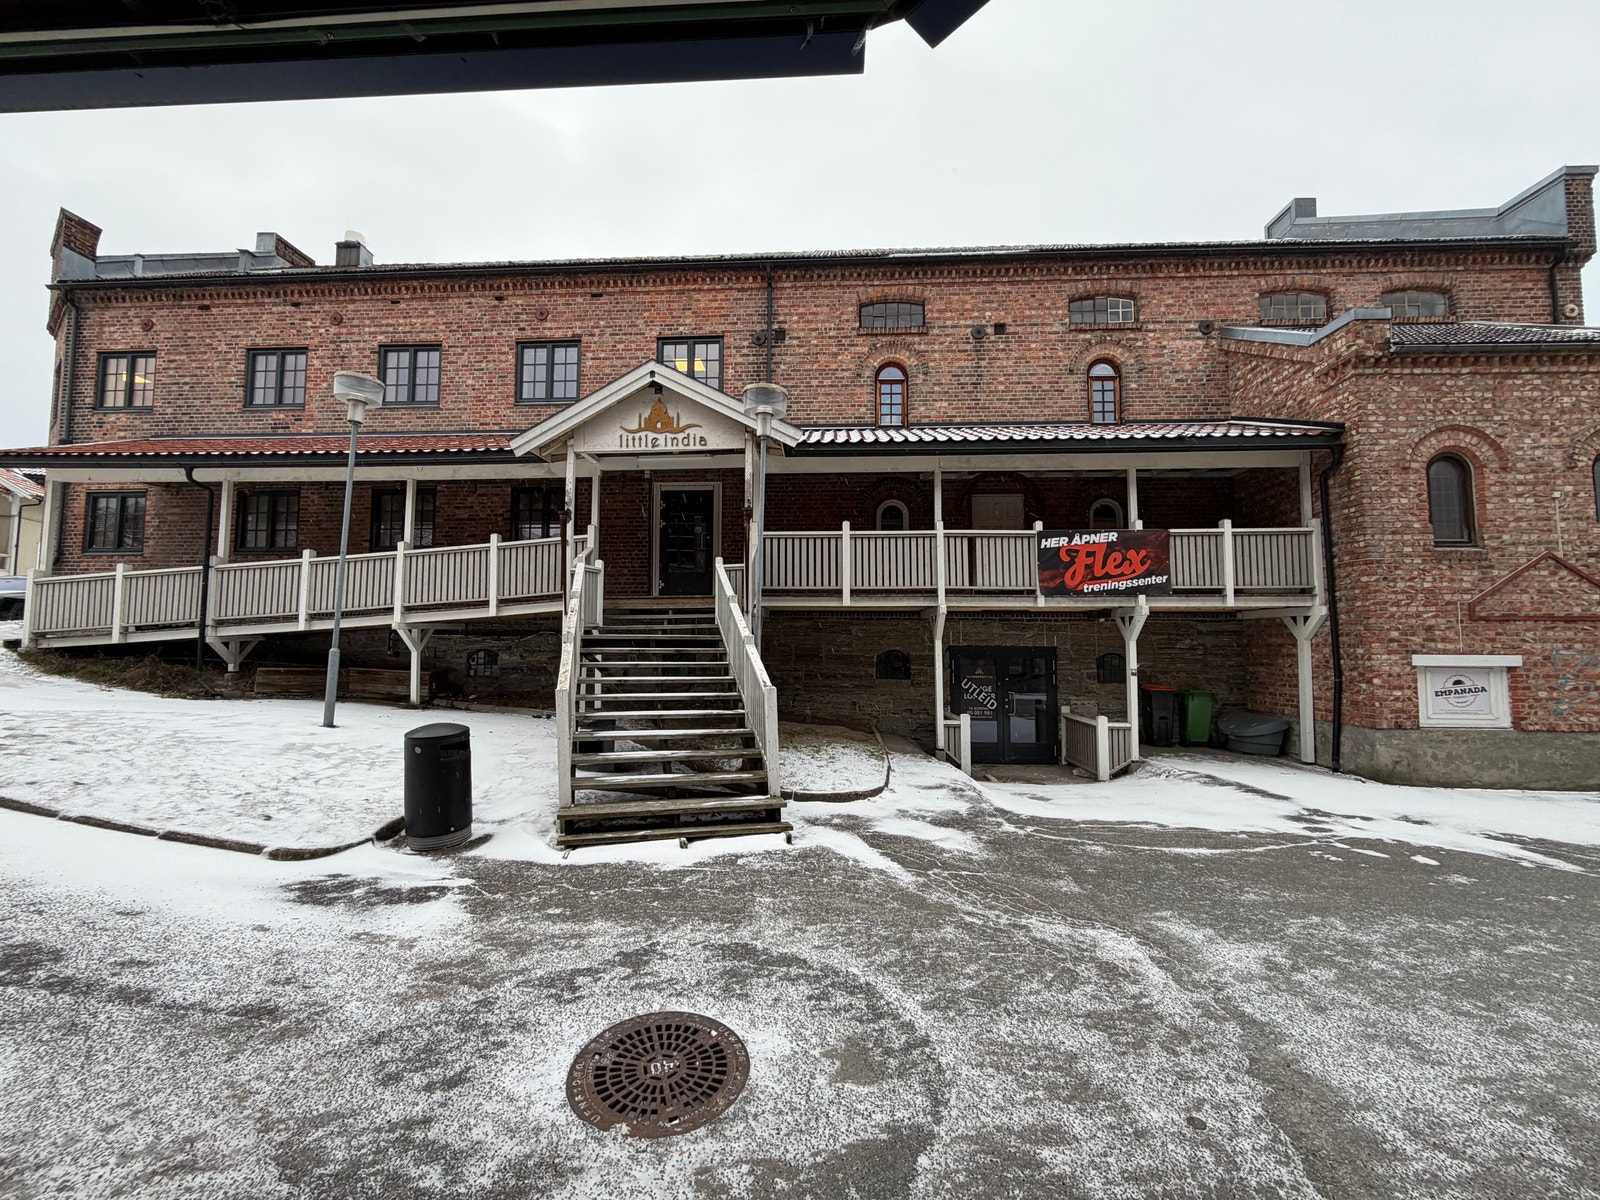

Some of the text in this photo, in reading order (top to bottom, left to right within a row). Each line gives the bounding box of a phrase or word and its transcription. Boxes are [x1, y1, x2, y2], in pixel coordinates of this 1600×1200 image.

[619, 433, 707, 448] little india
[1040, 532, 1118, 549] HER ÅPNER
[1059, 543, 1152, 590] Flex
[1083, 575, 1168, 593] treningssenter
[961, 678, 997, 710] UTLEID
[1434, 686, 1488, 697] EMPANADA
